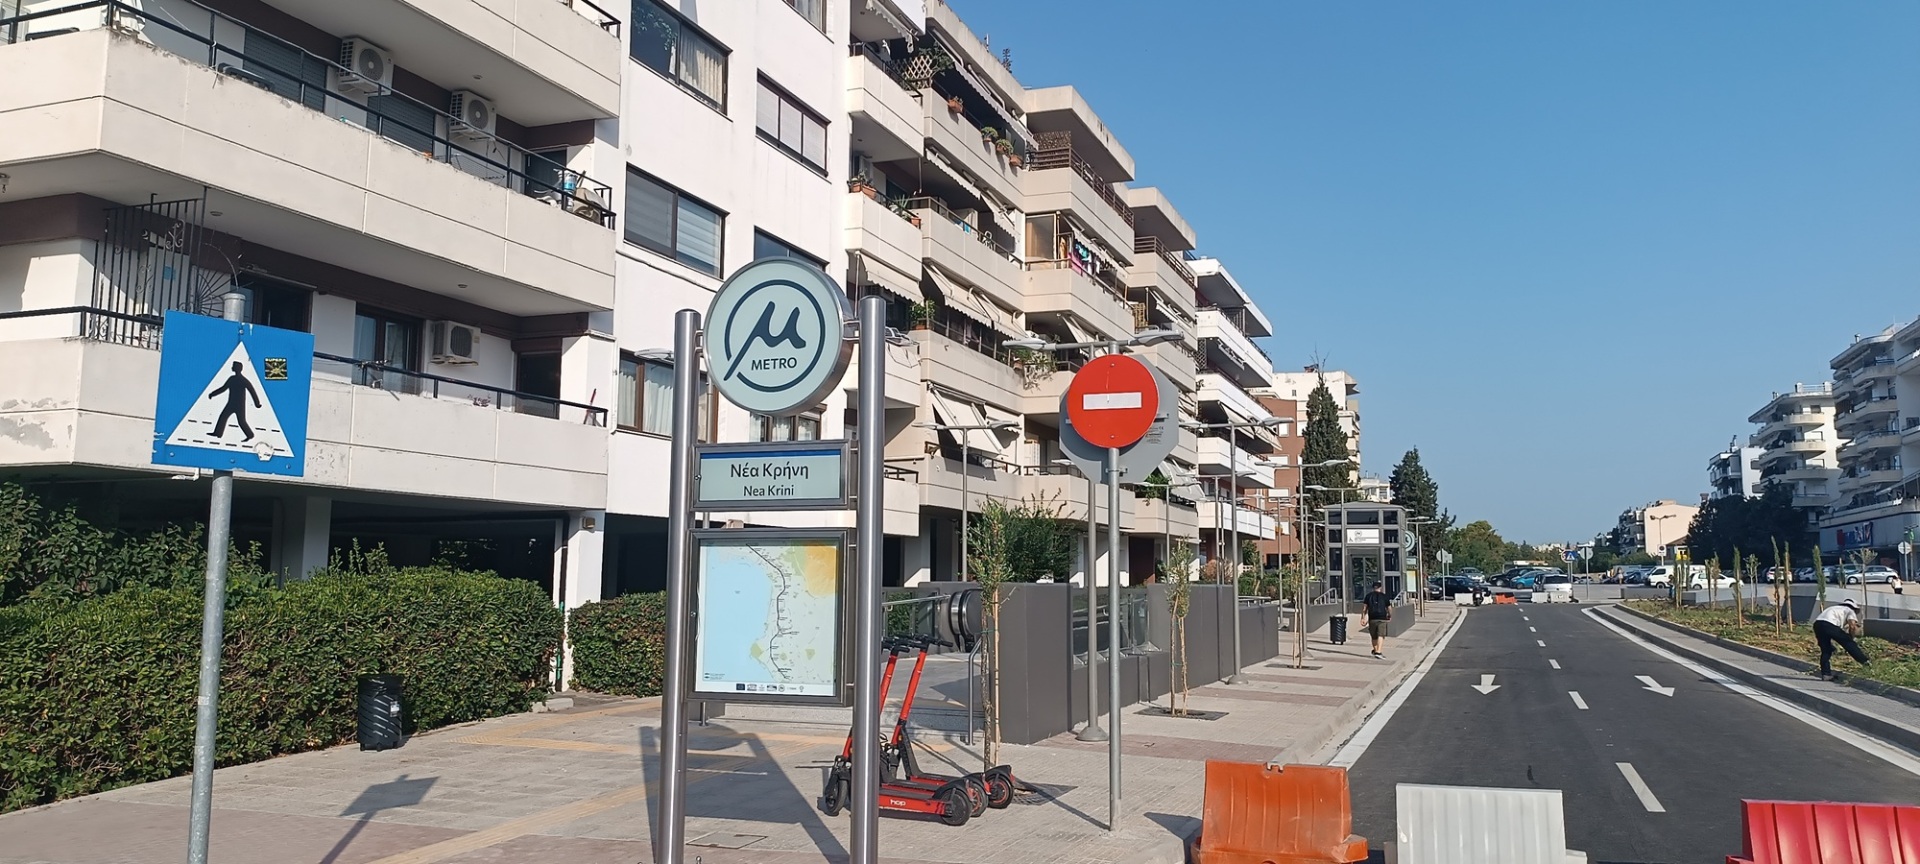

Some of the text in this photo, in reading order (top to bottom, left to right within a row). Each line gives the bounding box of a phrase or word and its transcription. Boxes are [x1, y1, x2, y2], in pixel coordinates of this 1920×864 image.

[751, 357, 797, 371] METRO
[730, 461, 809, 480] Νέα Κρήνη
[743, 484, 794, 497] Nea Krini
[890, 799, 906, 807] hop
